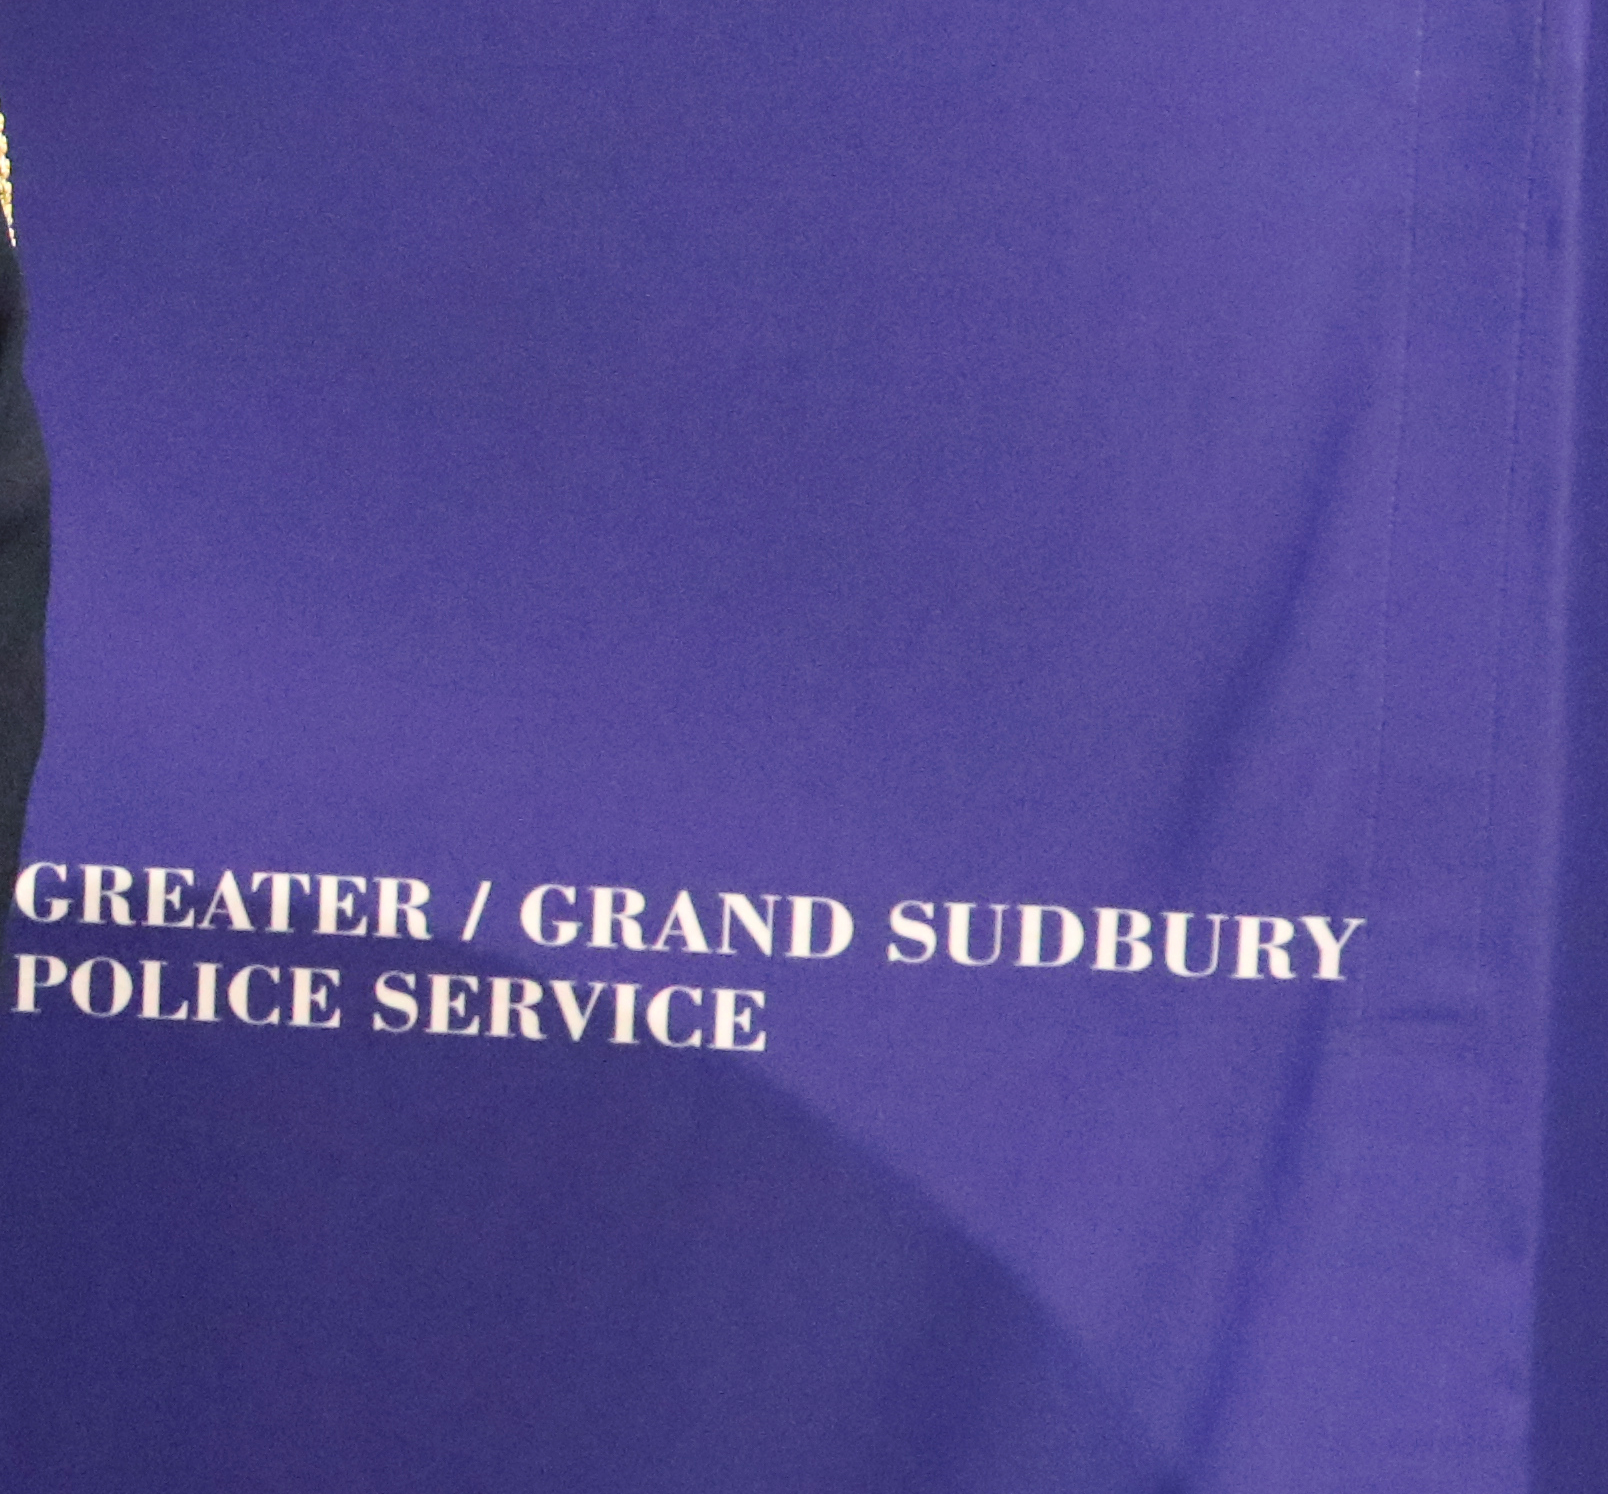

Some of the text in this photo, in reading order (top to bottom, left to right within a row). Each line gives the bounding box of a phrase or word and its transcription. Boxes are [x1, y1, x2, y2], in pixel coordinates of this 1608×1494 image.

[15, 862, 1365, 980] GREATER / GRAND SUDBURY
[13, 954, 766, 1051] POLICE SERVICE
